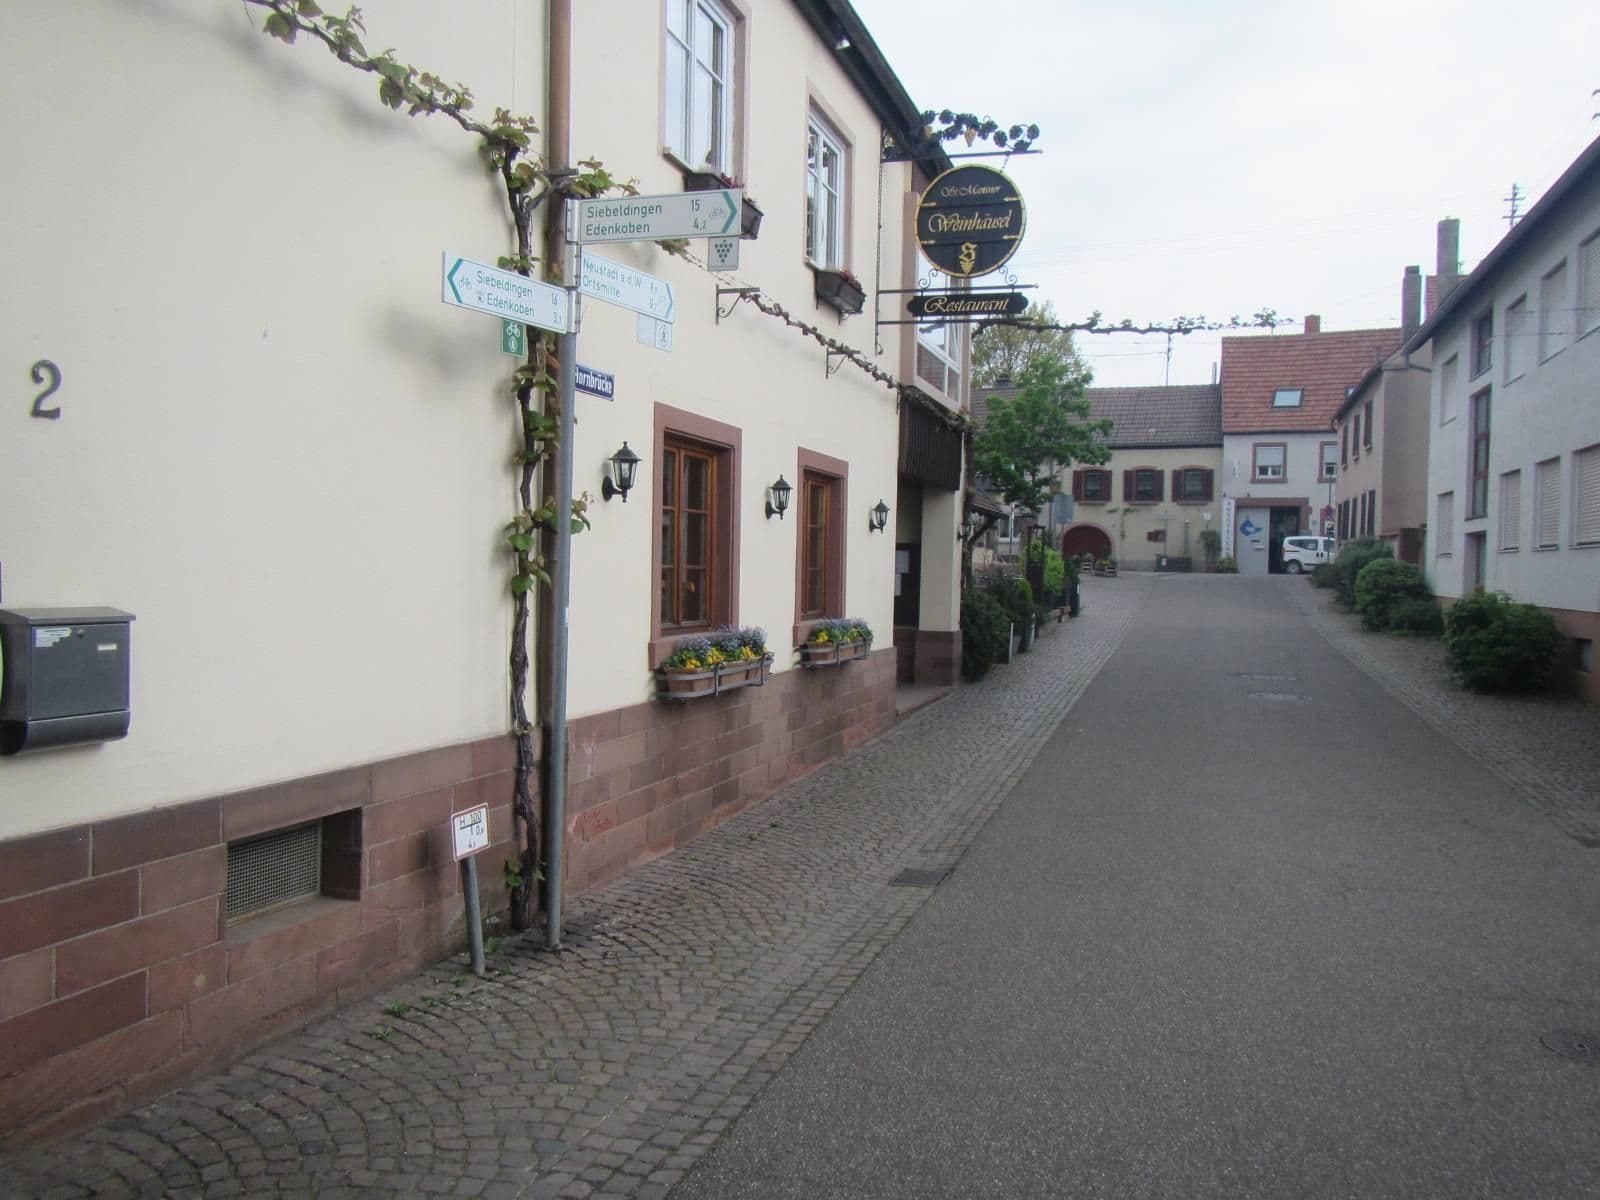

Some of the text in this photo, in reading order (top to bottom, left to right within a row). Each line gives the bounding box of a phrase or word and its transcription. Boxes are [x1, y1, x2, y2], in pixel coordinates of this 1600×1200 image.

[586, 200, 701, 219] Siebeldingen 15
[929, 209, 1013, 232] Weinhäusel
[585, 222, 650, 237] Edenkoben
[583, 257, 619, 279] Neustadt
[476, 270, 533, 298] Siebeldingen
[487, 292, 535, 318] Edenkoben
[924, 296, 1010, 313] Restaurant
[31, 359, 62, 420] 2
[459, 816, 466, 827] H
